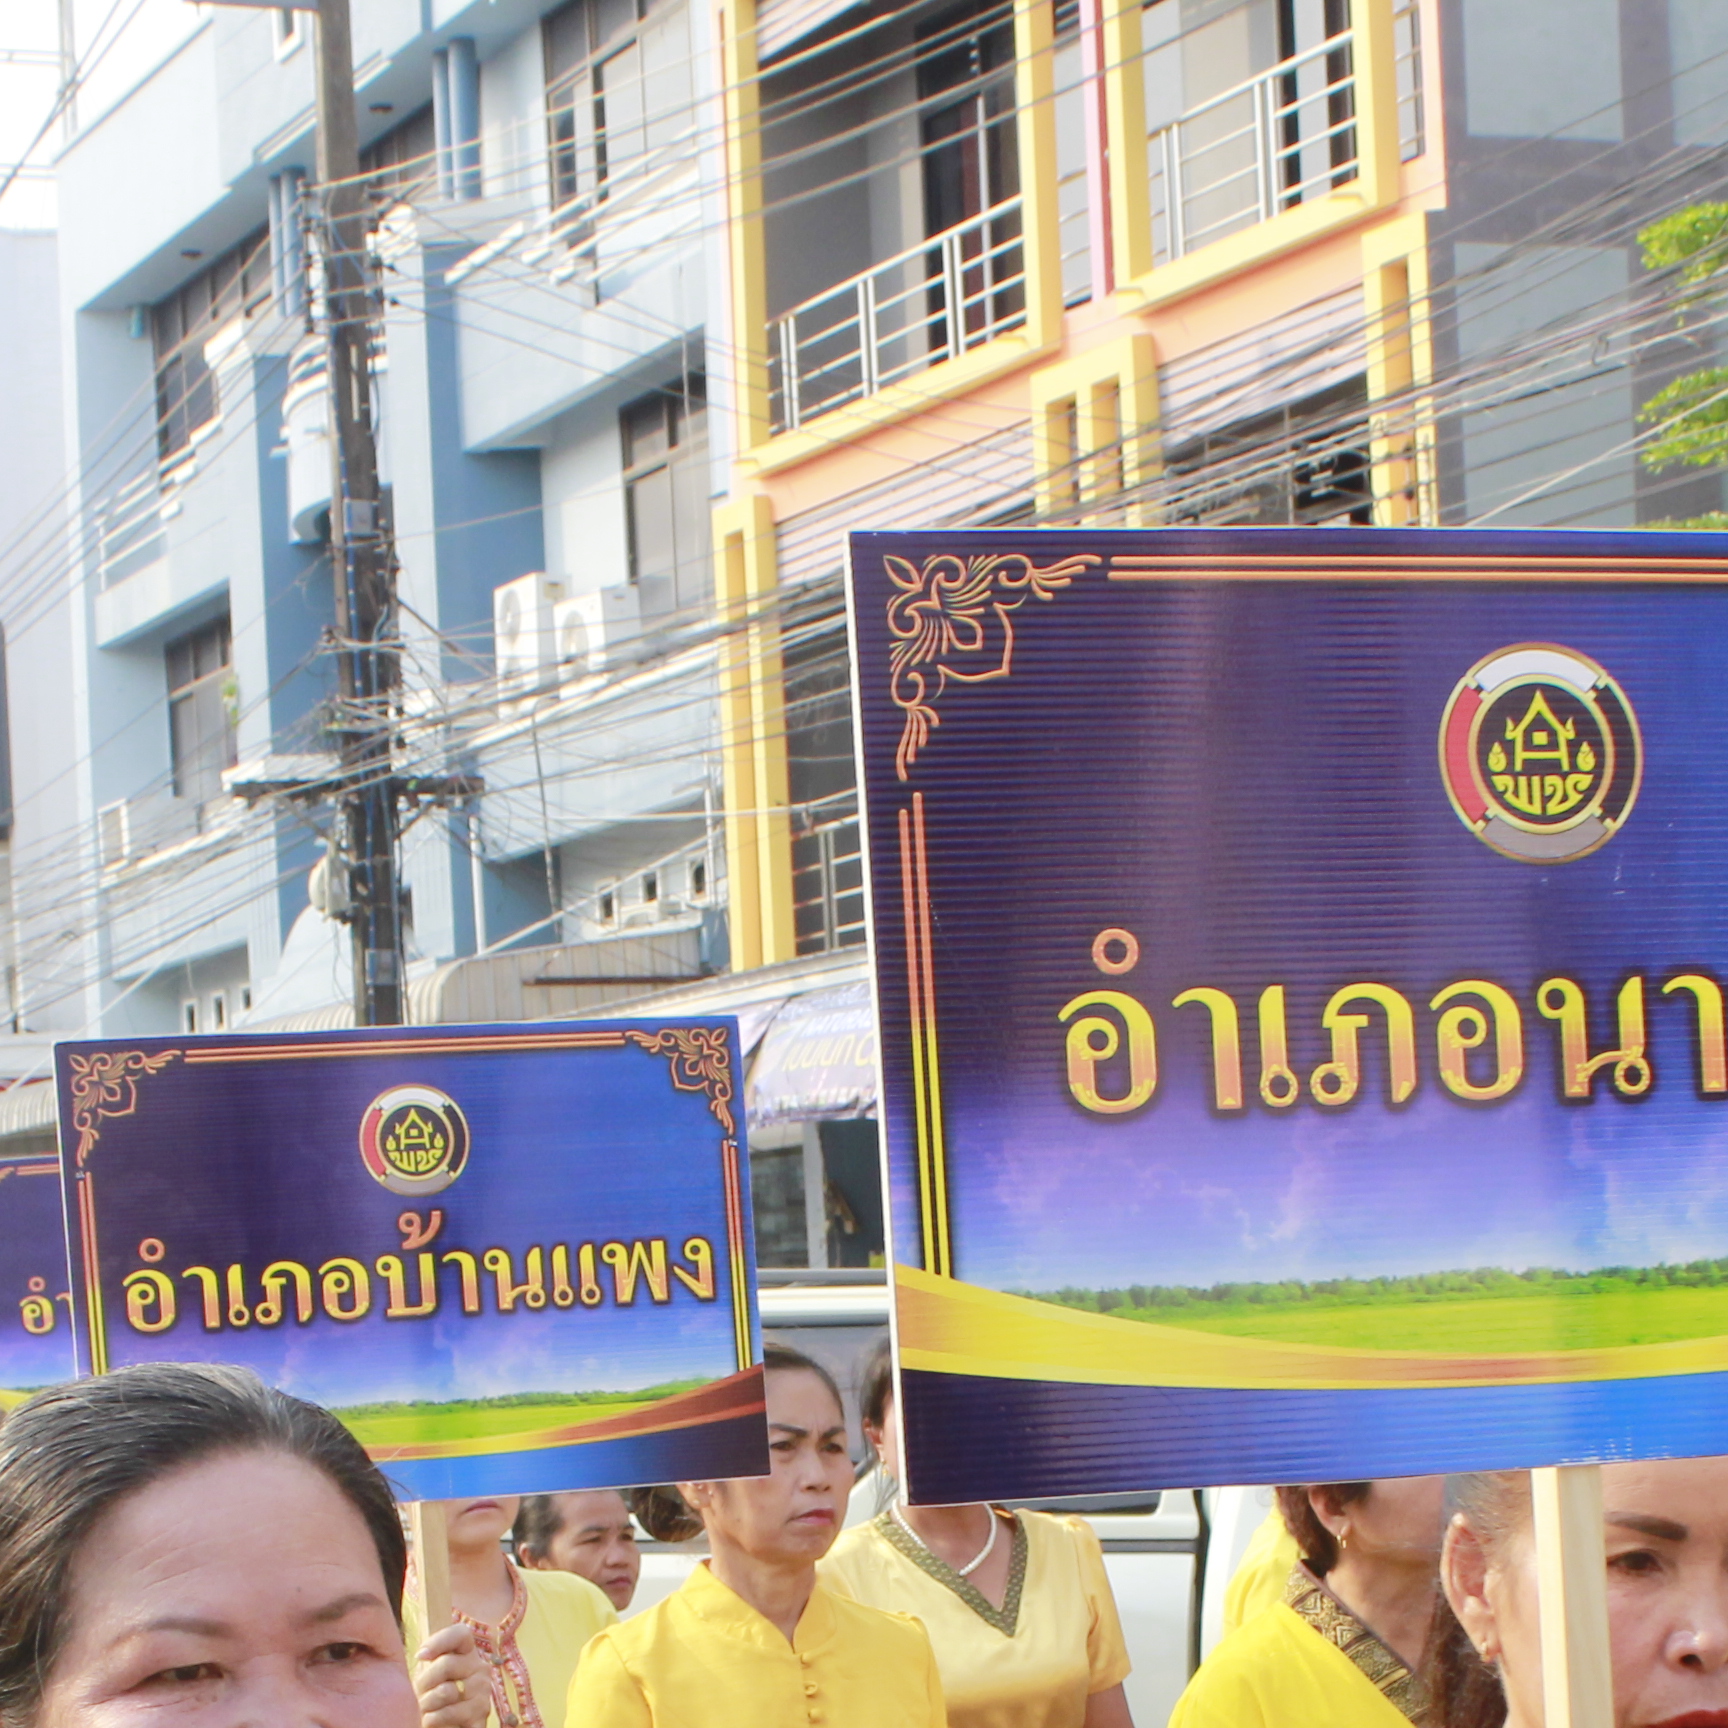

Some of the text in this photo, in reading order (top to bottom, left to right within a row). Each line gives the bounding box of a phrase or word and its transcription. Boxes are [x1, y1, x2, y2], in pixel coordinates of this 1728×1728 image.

[122, 1209, 716, 1334] อำเภอบ้านแพง
